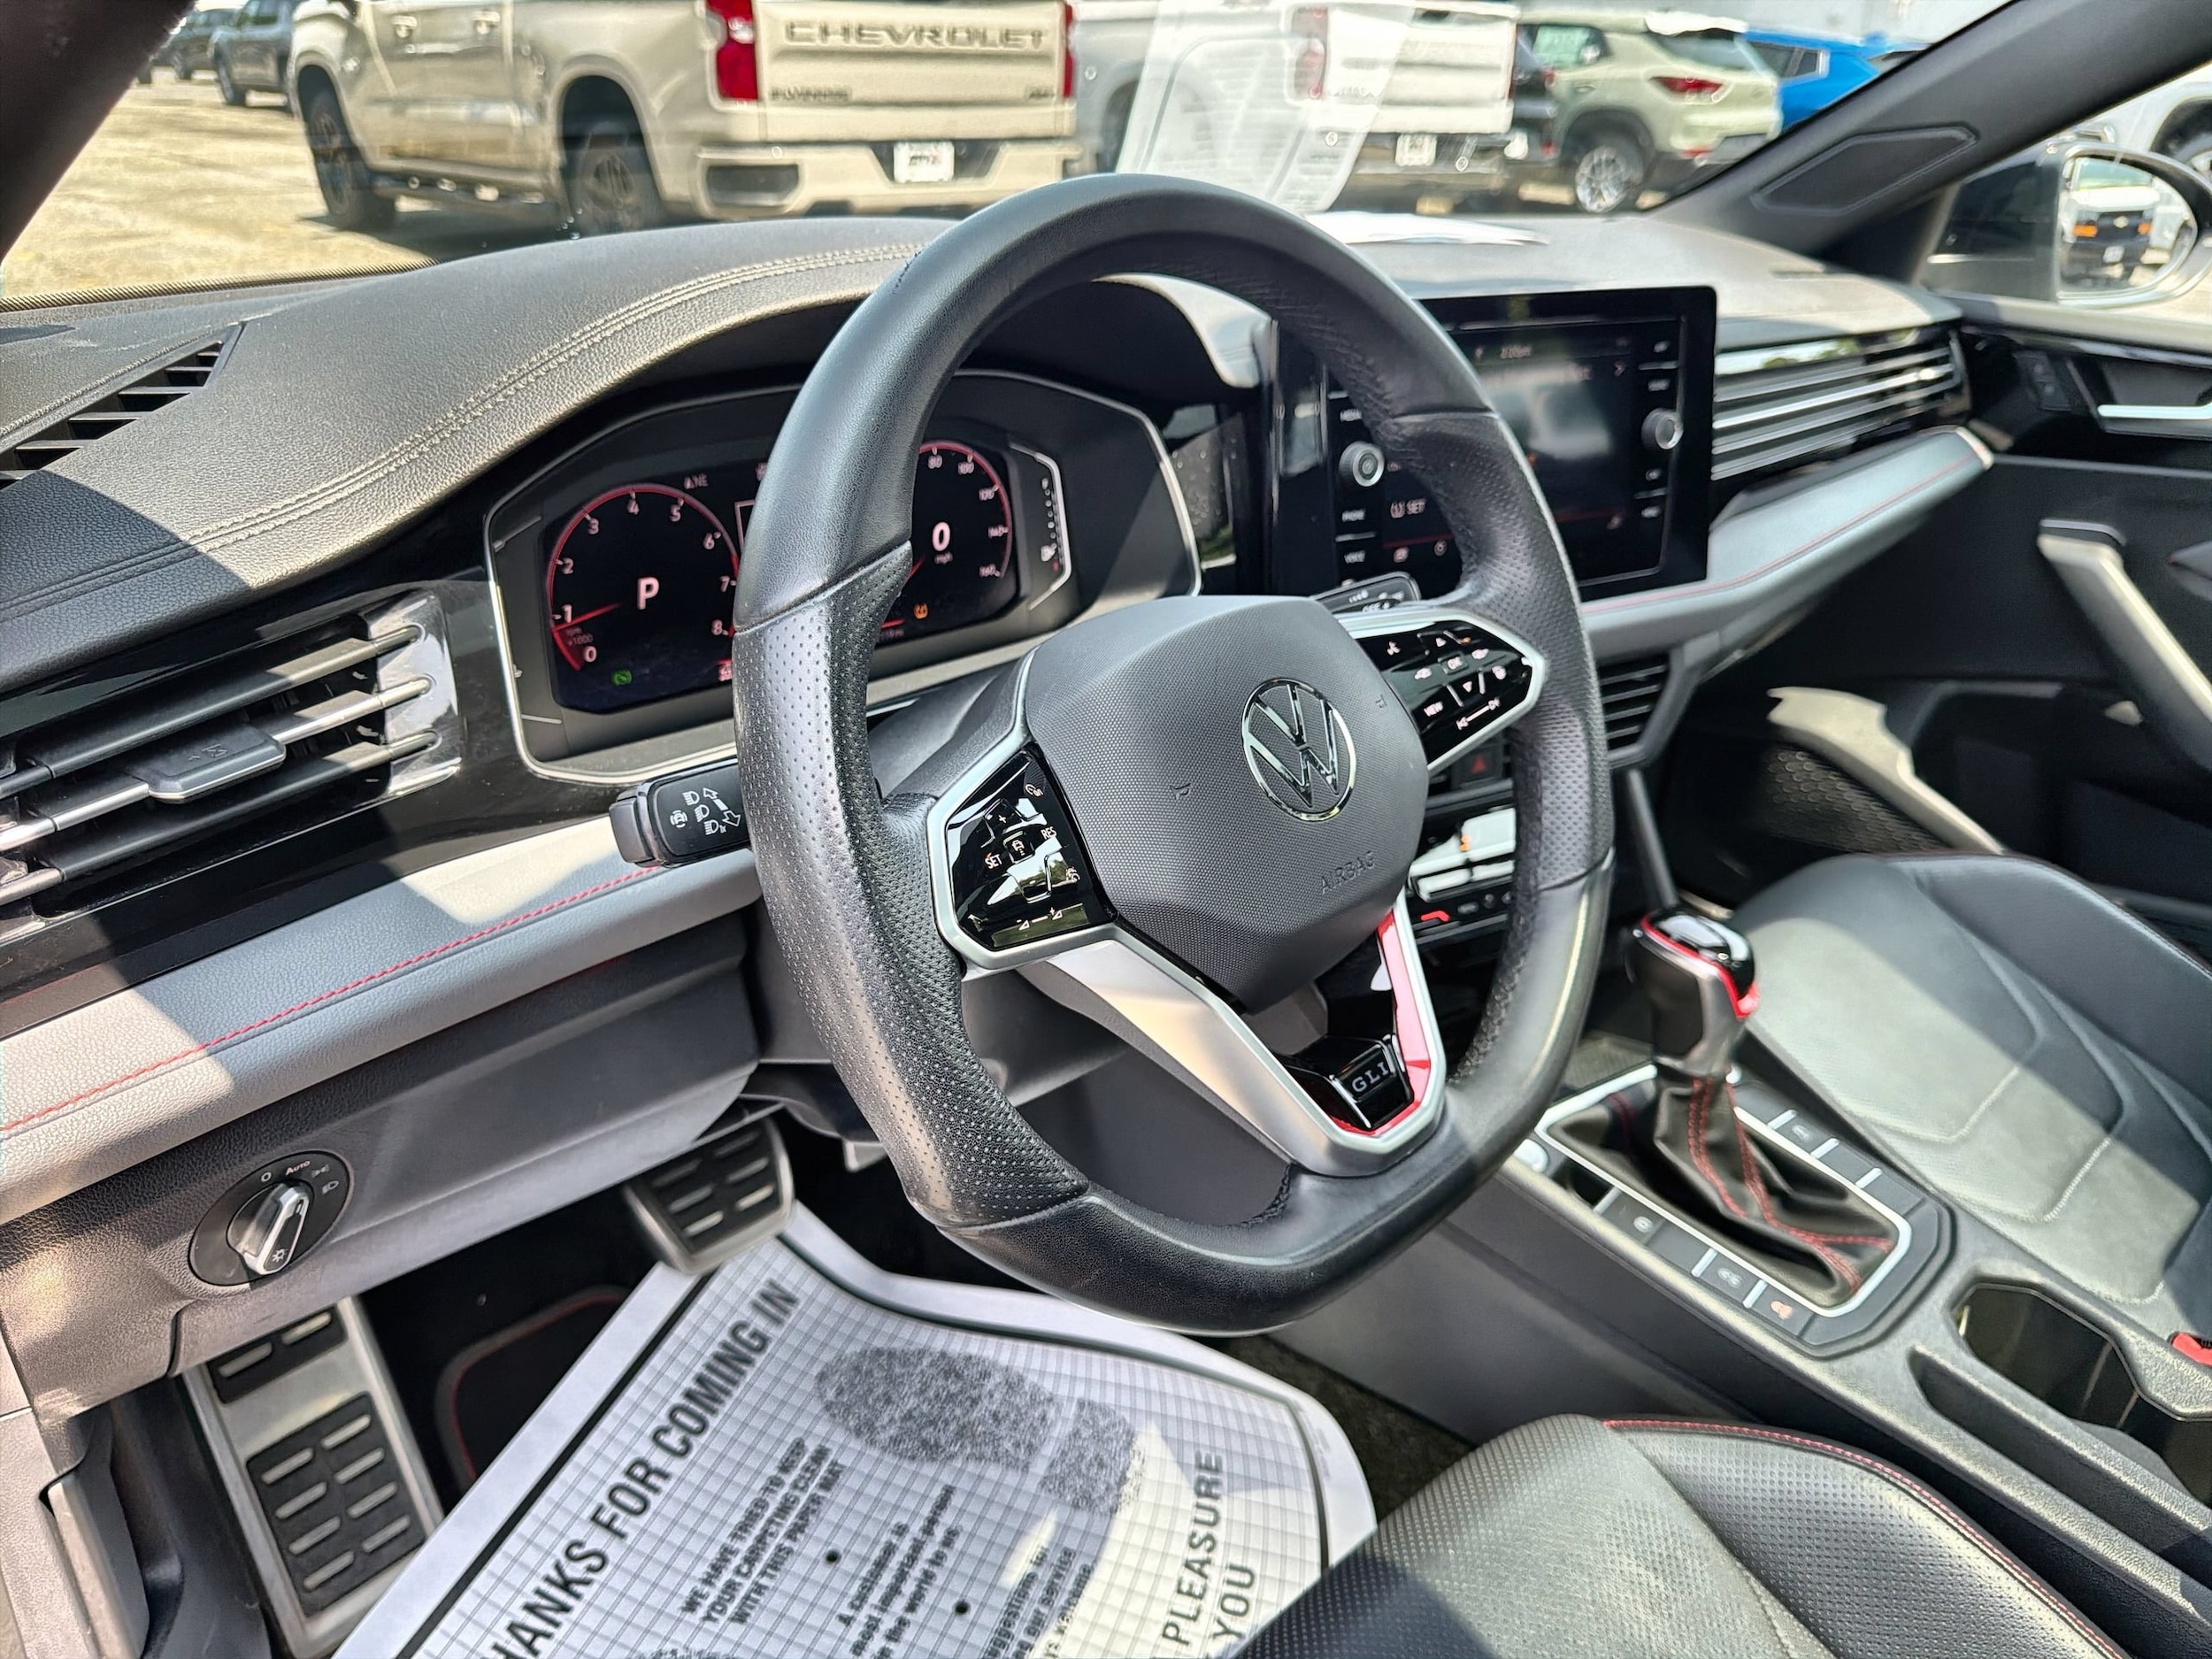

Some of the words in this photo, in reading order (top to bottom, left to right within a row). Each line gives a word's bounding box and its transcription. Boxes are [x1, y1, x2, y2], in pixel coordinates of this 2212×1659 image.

[784, 21, 1043, 50] CHEVROLET
[626, 503, 640, 515] 4
[670, 503, 681, 522] 5
[588, 518, 600, 534] 3
[703, 533, 715, 550] 6
[932, 521, 951, 551] 0
[562, 557, 574, 574] 2
[636, 577, 660, 610] P
[719, 576, 730, 593] 7
[562, 603, 572, 623] 1
[711, 619, 723, 635] 8
[583, 645, 597, 663] 0
[1041, 826, 1057, 840] RES
[985, 854, 1002, 869] SET
[1320, 850, 1375, 895] AIRBAG
[1351, 1061, 1389, 1093] GLI
[588, 1455, 671, 1540] FOR
[651, 1319, 772, 1459] COMING
[749, 1278, 799, 1328] IN
[680, 1586, 709, 1614] WE
[699, 1542, 739, 1587] HAVE
[727, 1496, 769, 1542] TRIED
[758, 1475, 785, 1499] TO
[701, 1578, 742, 1624] YOUR
[733, 1492, 800, 1578] CARPETING
[788, 1444, 832, 1493] CLEAN
[1162, 1451, 1224, 1646] PLEASURE
[728, 1581, 769, 1624] WITH
[758, 1542, 794, 1579] THIS
[784, 1492, 826, 1541] PAPER
[849, 1614, 882, 1656] most
[871, 1538, 926, 1613] important
[918, 1485, 956, 1536] person
[848, 1540, 898, 1611] customer
[1038, 1547, 1076, 1607] service
[884, 1616, 910, 1643] the
[904, 1568, 936, 1613] world
[1212, 1563, 1255, 1639] YOU
